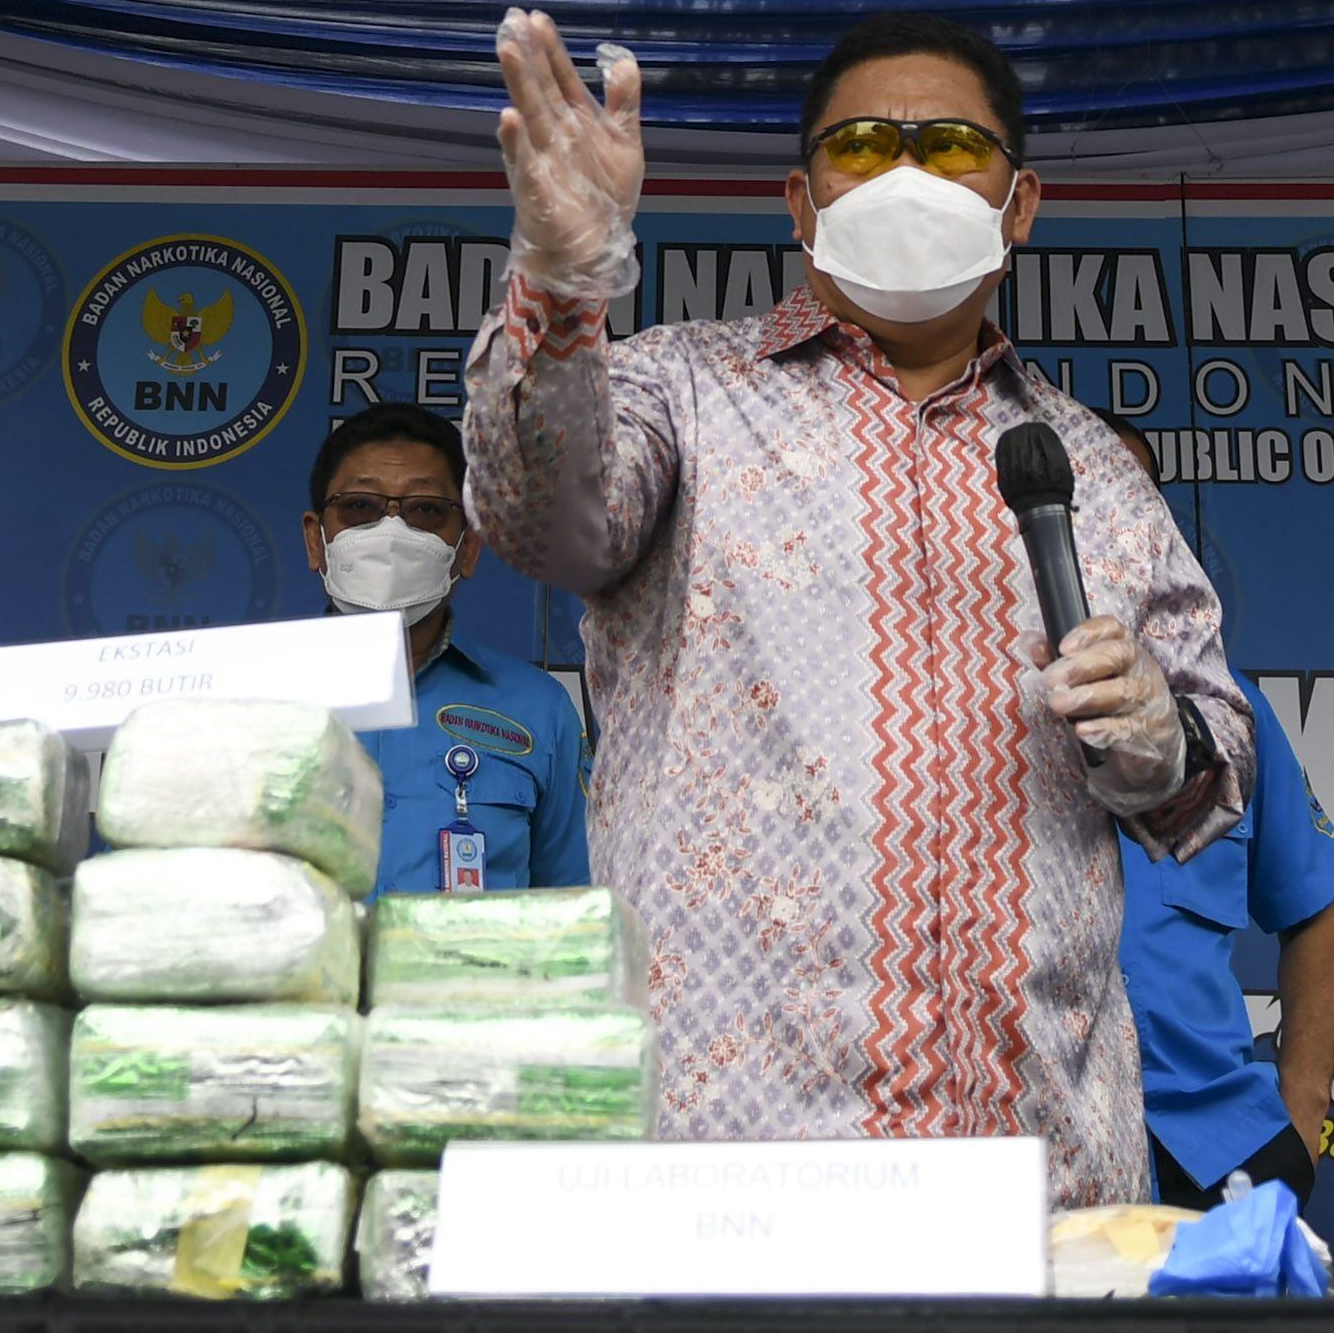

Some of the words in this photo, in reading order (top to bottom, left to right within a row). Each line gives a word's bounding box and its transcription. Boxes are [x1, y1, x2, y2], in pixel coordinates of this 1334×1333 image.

[82, 271, 128, 326] BADAN
[127, 245, 230, 278] NARKOTIKA
[231, 256, 292, 329] NASIONAL
[134, 380, 228, 412] BNN
[88, 396, 170, 456] REPUBLIK
[175, 401, 273, 457] INDONESIA
[1145, 430, 1291, 482] UBLIC
[98, 637, 196, 664] EKSTASI
[63, 678, 133, 703] 9.980
[138, 672, 215, 698] BUTIR
[441, 712, 464, 727] BADAN
[557, 1163, 611, 1191] UJI
[622, 1160, 920, 1191] LABORATORIUM
[695, 1211, 773, 1240] BNN
